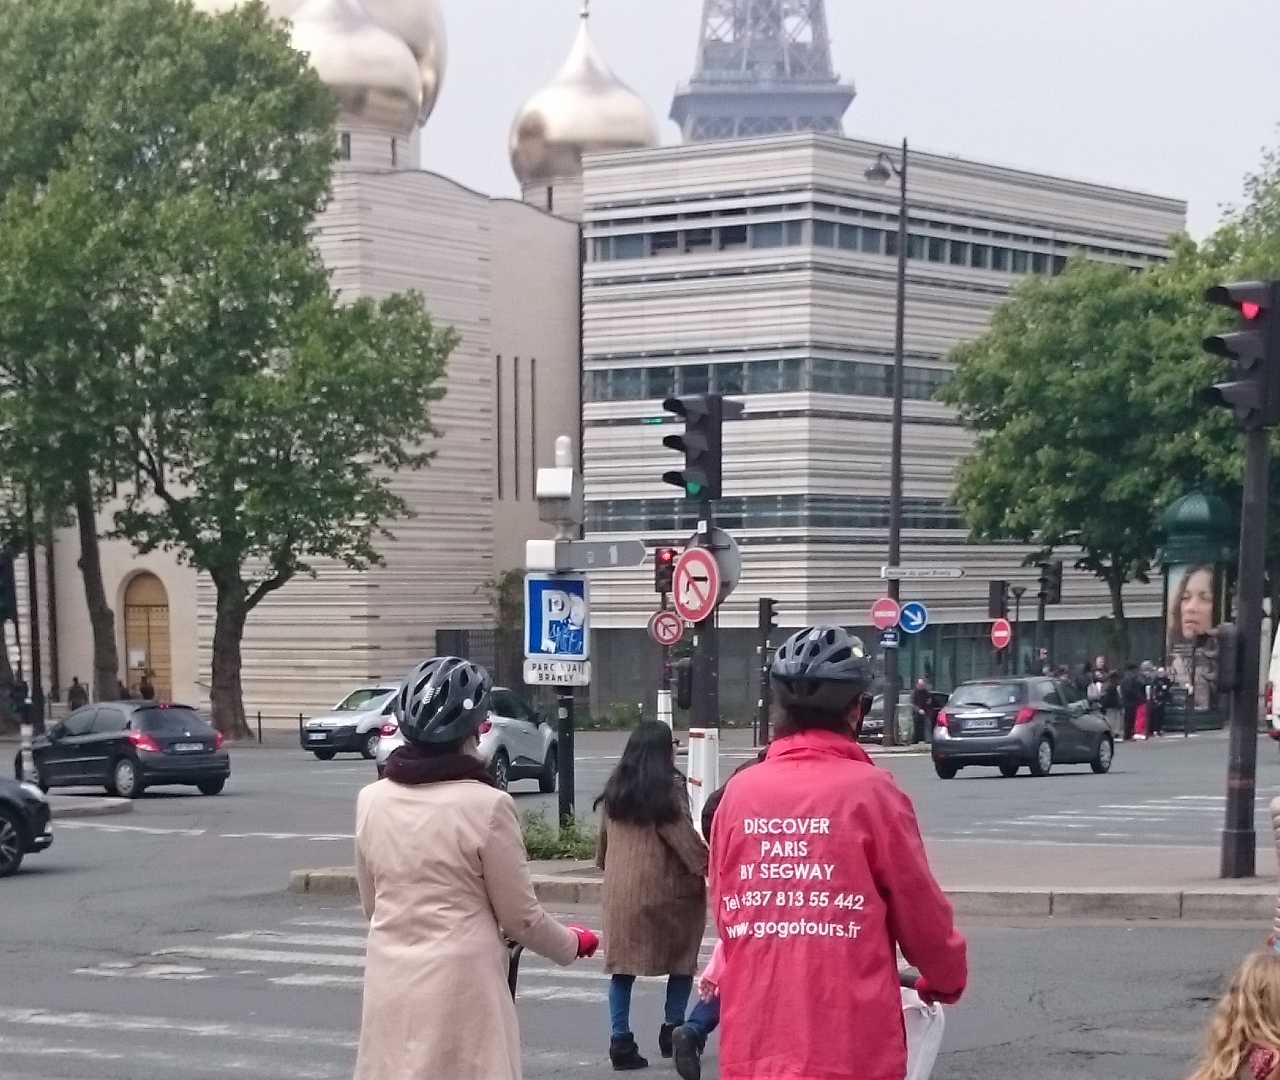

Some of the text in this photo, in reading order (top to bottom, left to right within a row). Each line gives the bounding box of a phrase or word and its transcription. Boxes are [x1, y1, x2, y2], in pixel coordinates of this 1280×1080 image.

[532, 663, 555, 671] PARC
[538, 673, 574, 682] BRANLY
[744, 818, 830, 834] DISCOVER
[760, 841, 808, 857] PARIS
[740, 863, 835, 880] BY SEGWAY
[722, 893, 741, 912] Tel
[775, 891, 804, 907] 813
[809, 892, 829, 907] 55
[834, 893, 864, 911] 442
[725, 917, 861, 939] www.gogotours.fr
